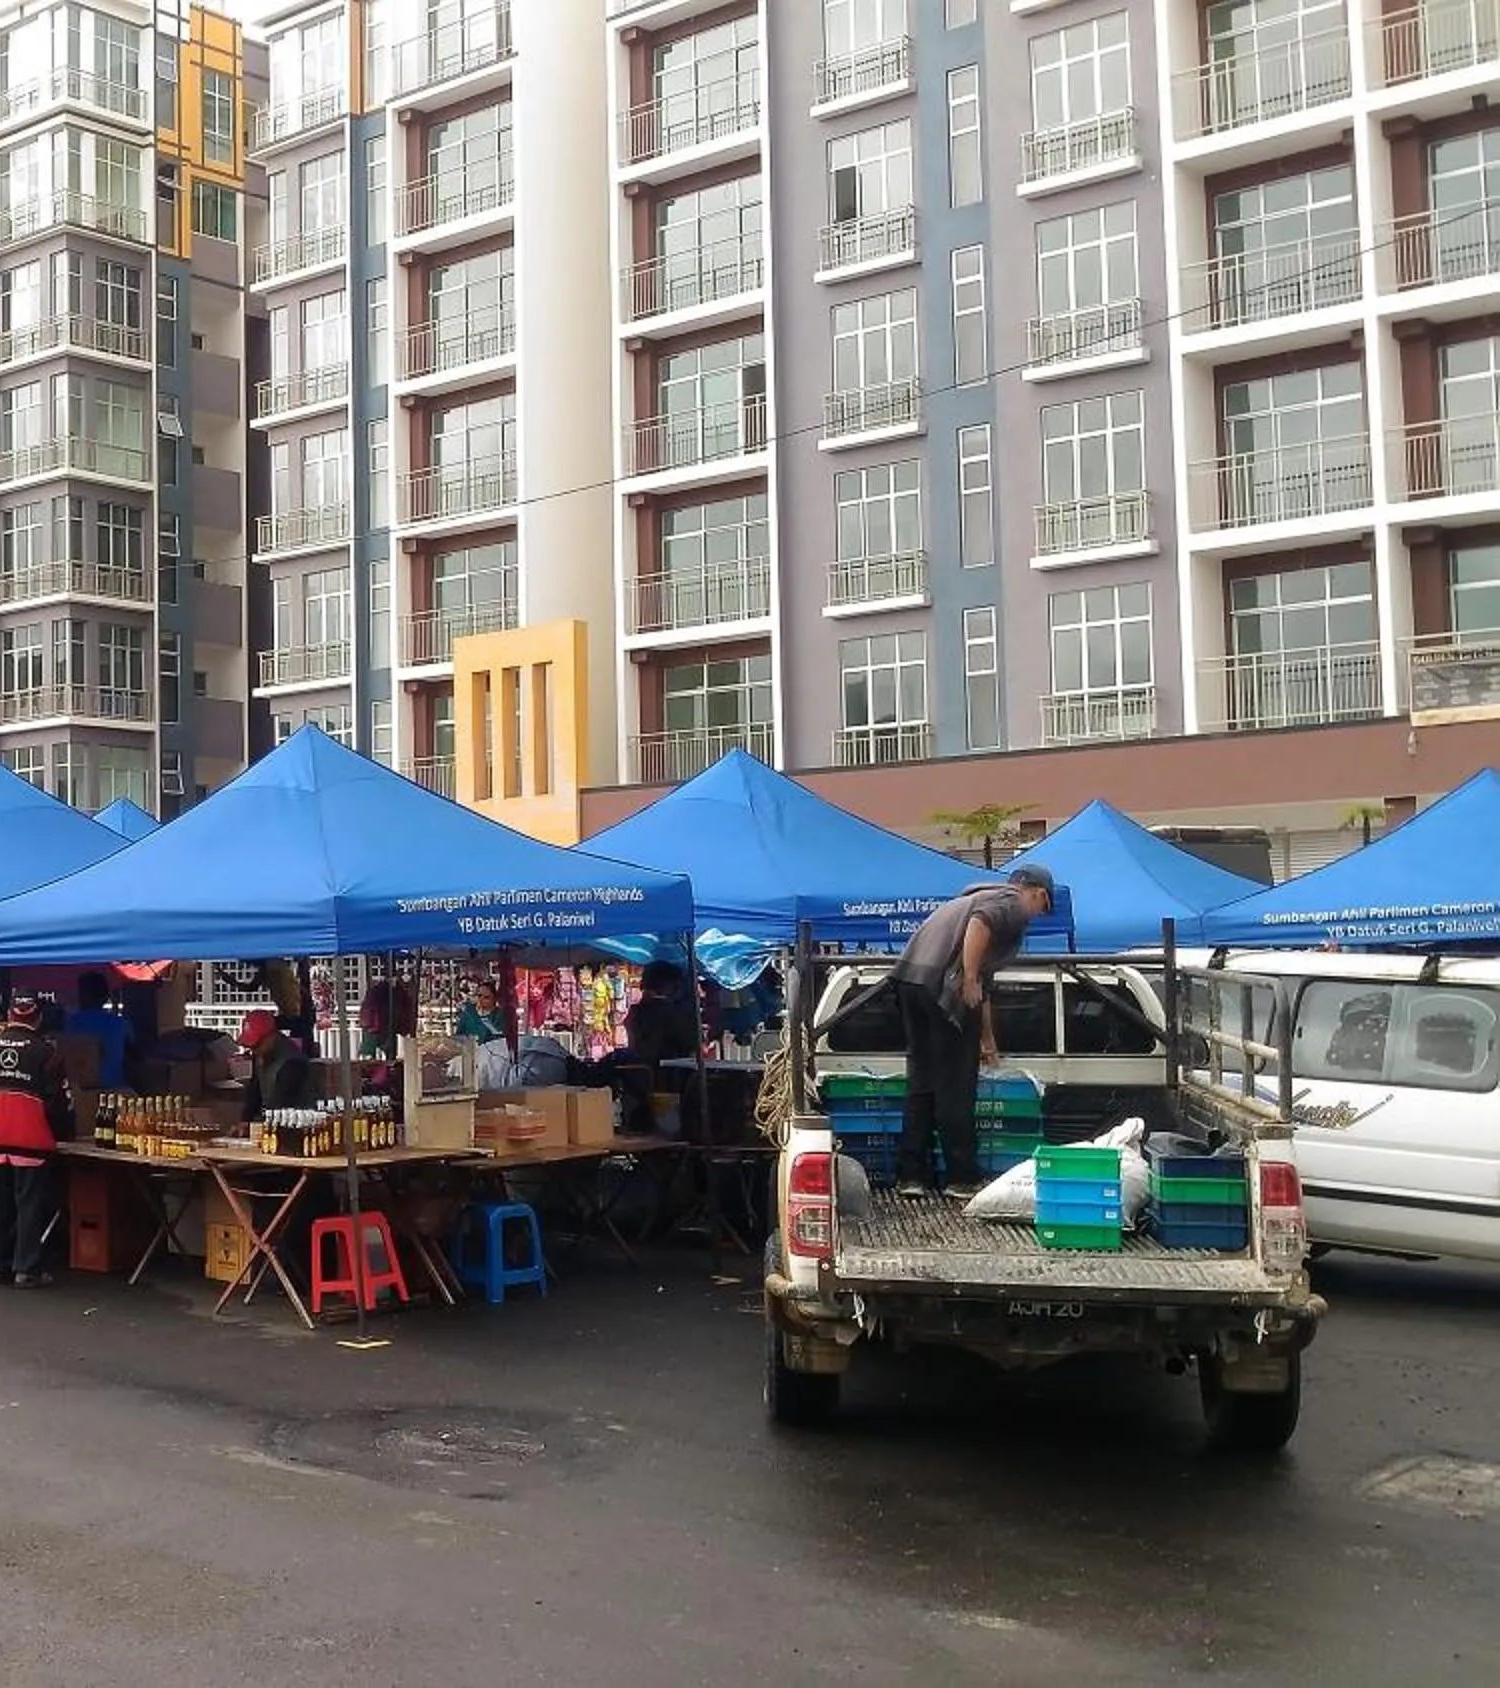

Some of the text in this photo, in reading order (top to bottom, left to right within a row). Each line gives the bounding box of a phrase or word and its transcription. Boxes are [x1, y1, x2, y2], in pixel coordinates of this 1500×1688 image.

[397, 893, 467, 913] Sumbangan
[493, 888, 543, 905] Parlimen
[543, 886, 592, 903] Cameron
[457, 917, 475, 933] YB
[476, 914, 509, 933] Datuk
[1263, 911, 1338, 925] Sumbangan
[1369, 904, 1429, 919] Parlimen
[1431, 903, 1495, 917] Cameron
[1347, 922, 1387, 937] Datuk
[1389, 921, 1415, 936] Seri
